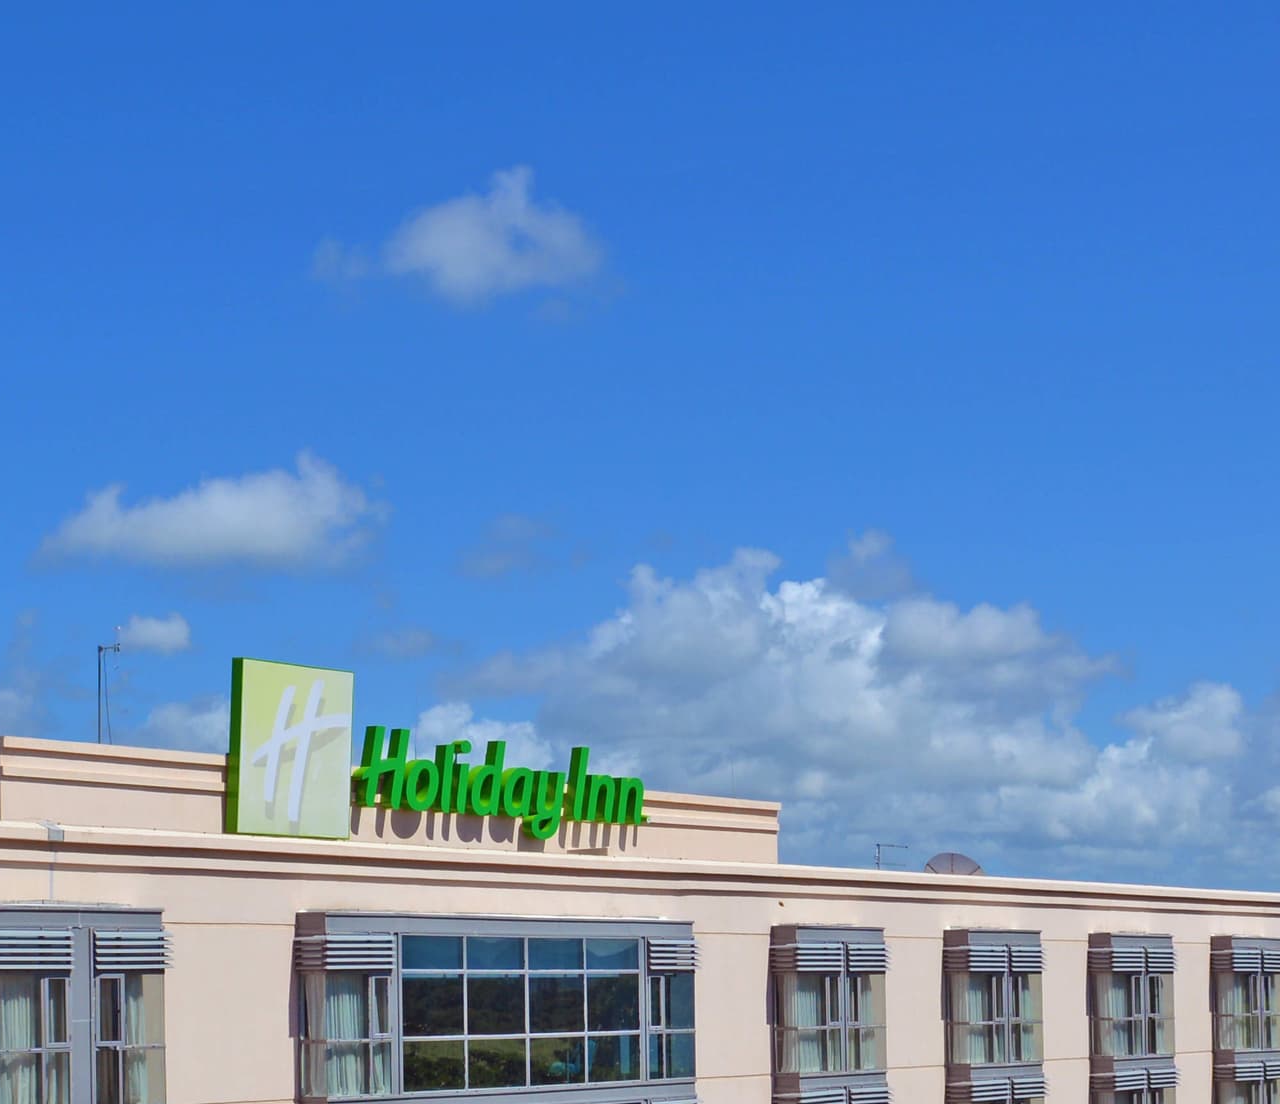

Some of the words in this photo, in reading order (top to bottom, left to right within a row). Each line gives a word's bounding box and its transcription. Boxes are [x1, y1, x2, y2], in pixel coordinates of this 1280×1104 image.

[252, 679, 351, 822] H
[351, 725, 566, 840] Holiday
[568, 746, 645, 825] Inn
